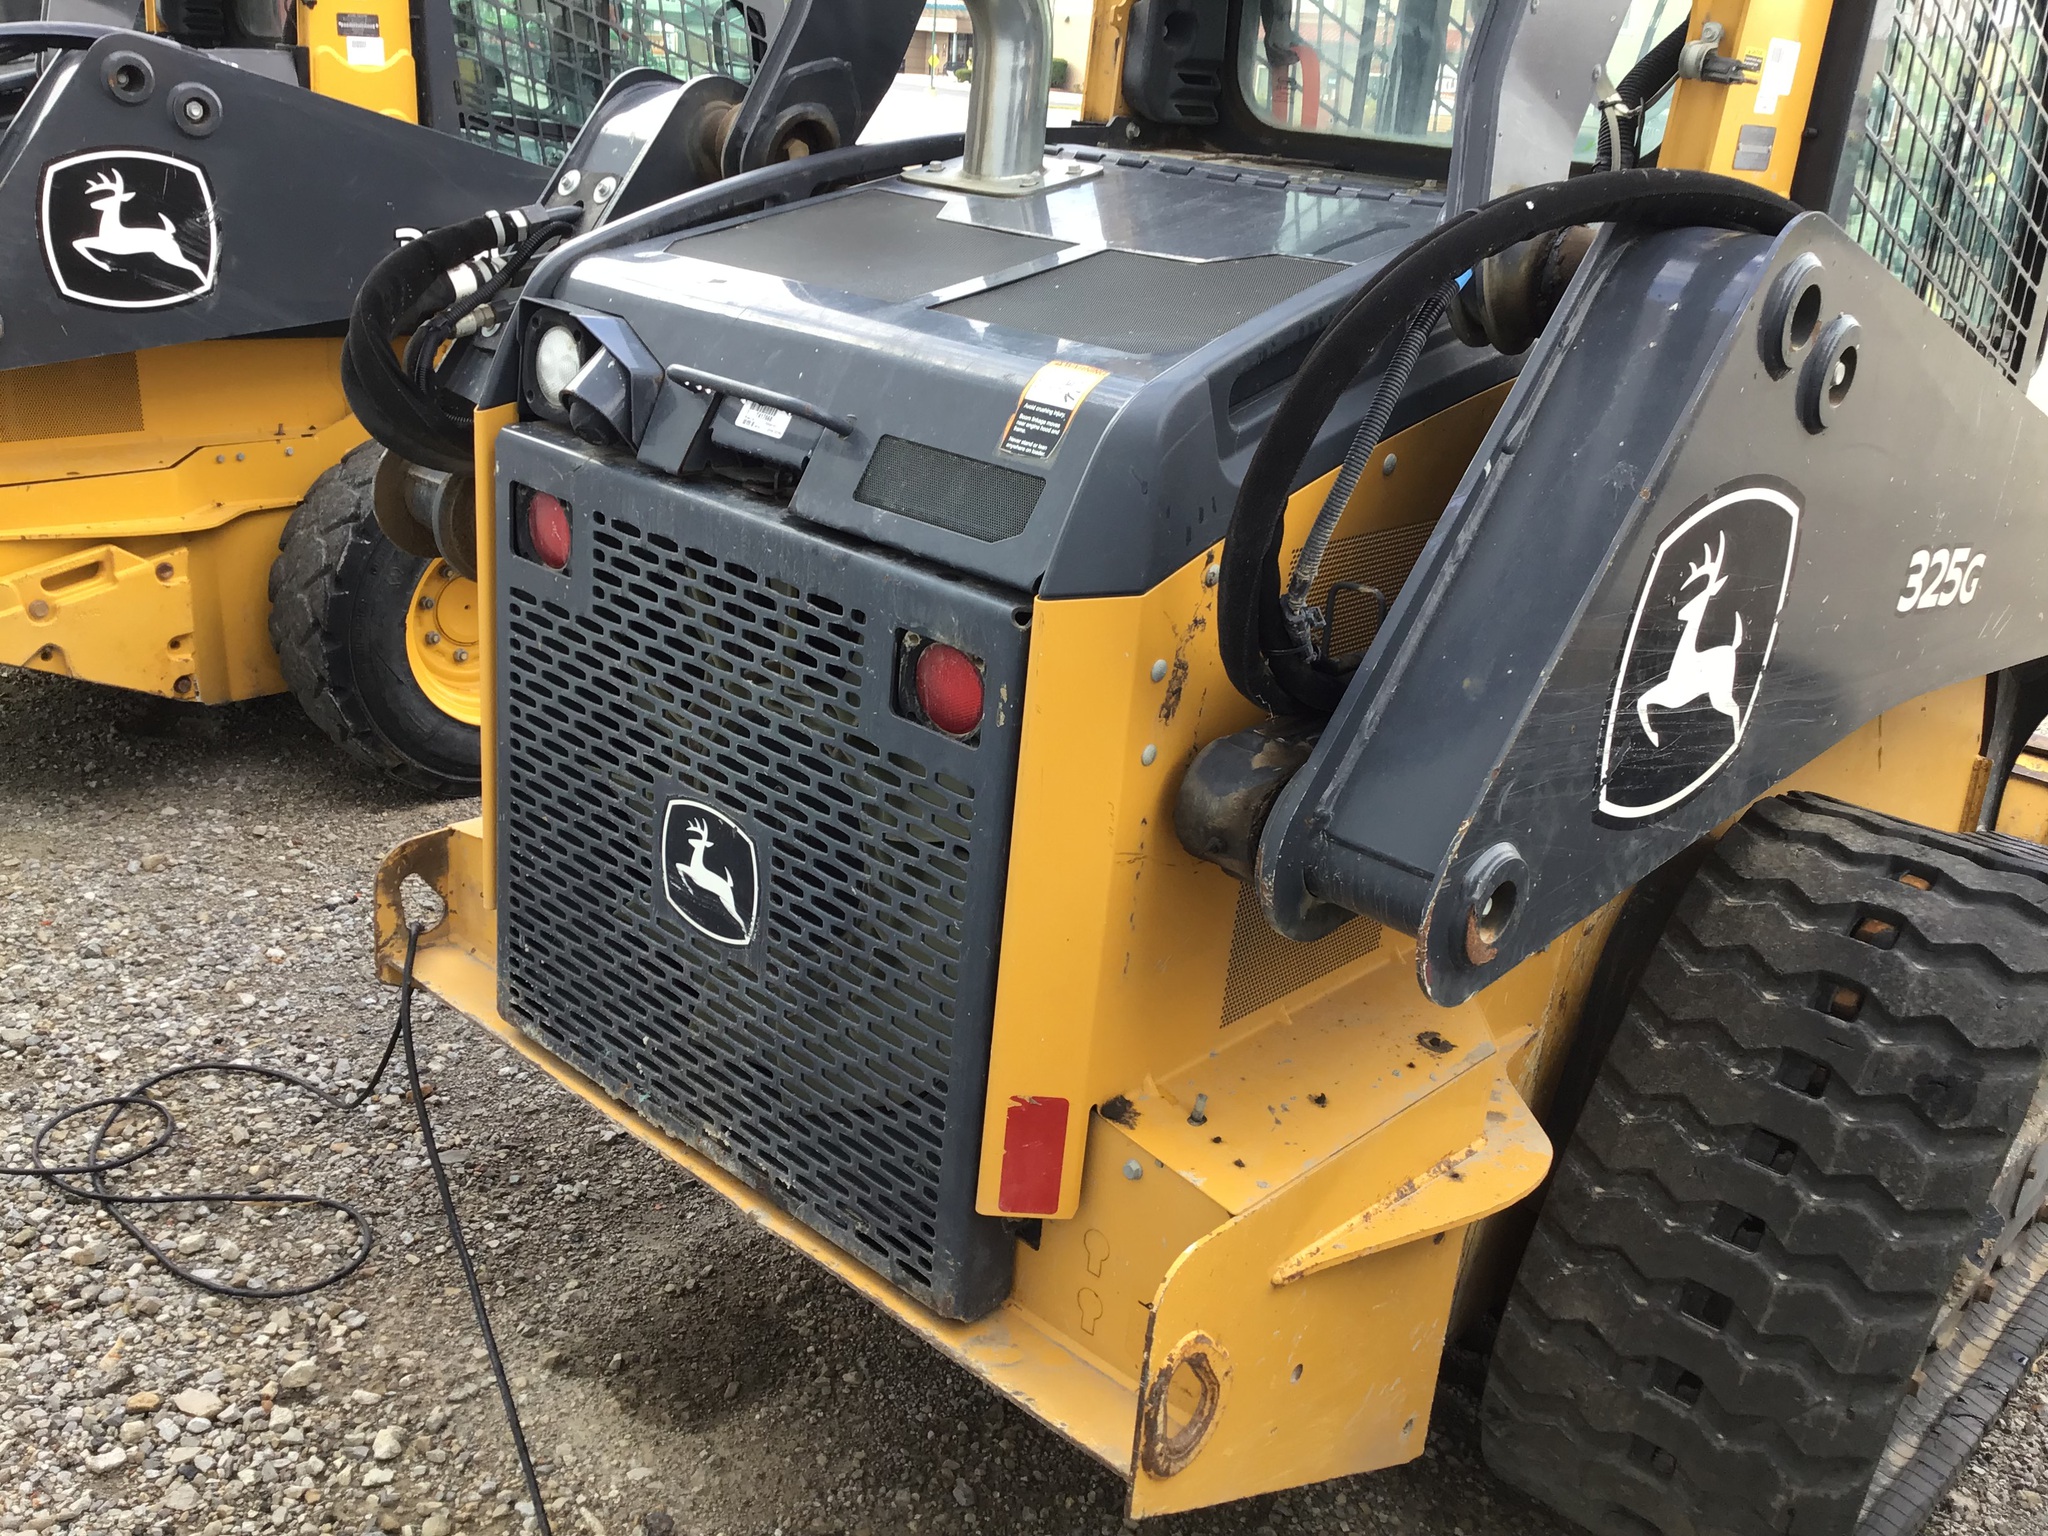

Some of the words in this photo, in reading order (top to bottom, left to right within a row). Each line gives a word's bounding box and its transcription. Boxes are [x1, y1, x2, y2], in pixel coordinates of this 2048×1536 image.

[1036, 406, 1053, 416] crushing
[1032, 416, 1046, 424] linkage
[1006, 443, 1025, 452] anywhere
[1896, 548, 1986, 612] 325G
